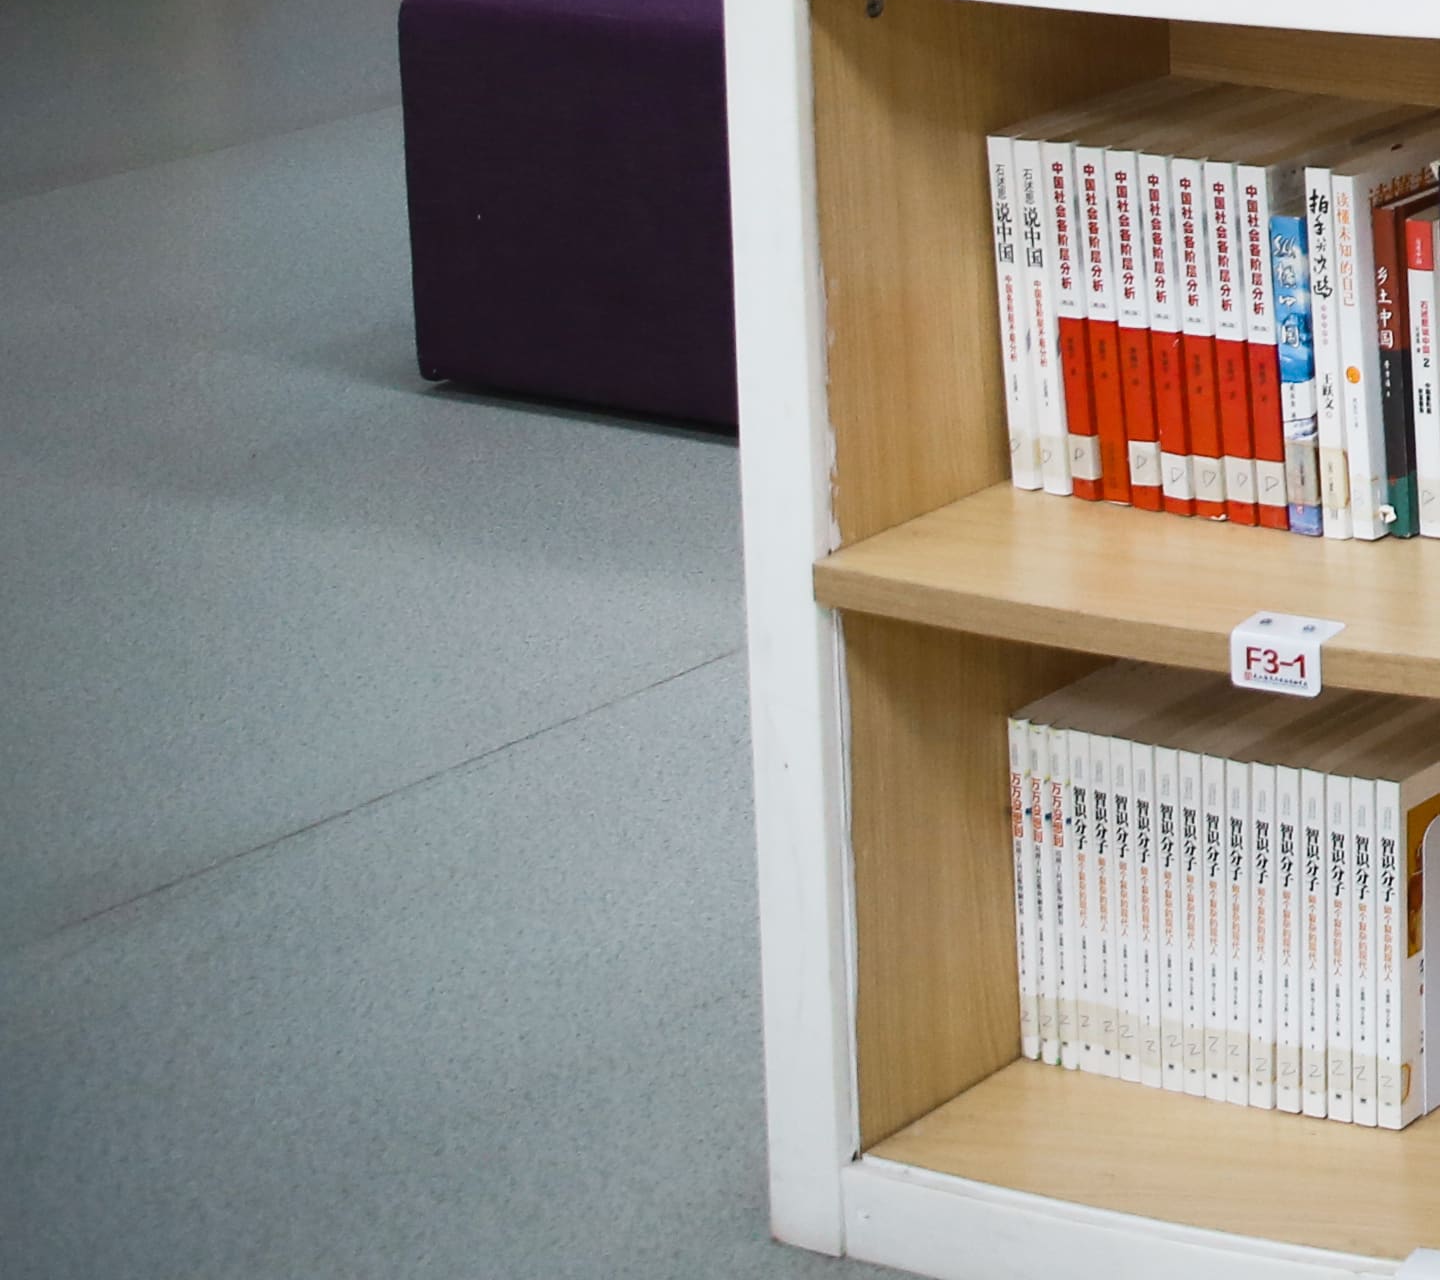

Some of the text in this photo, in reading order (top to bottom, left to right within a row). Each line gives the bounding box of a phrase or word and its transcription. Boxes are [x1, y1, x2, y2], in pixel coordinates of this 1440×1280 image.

[1051, 161, 1072, 290] 中国社会各阶层分析
[1083, 163, 1104, 292] 中国社会各阶层分析
[1114, 170, 1136, 300] 中国社会各阶层分析
[1147, 173, 1167, 304] 中国社会各阶层分析
[1179, 176, 1199, 307] 中国社会各阶层分析
[1376, 266, 1394, 349] 乡土中国
[1246, 646, 1305, 678] F3-1
[1072, 786, 1088, 851] 智识分子
[1093, 790, 1108, 855] 智识分子
[1115, 793, 1129, 858] 智识分子
[1136, 798, 1151, 864] 智识分子
[1160, 803, 1174, 868] 智识分子
[1183, 807, 1197, 871] 智识分子
[1206, 813, 1220, 878] 智识分子
